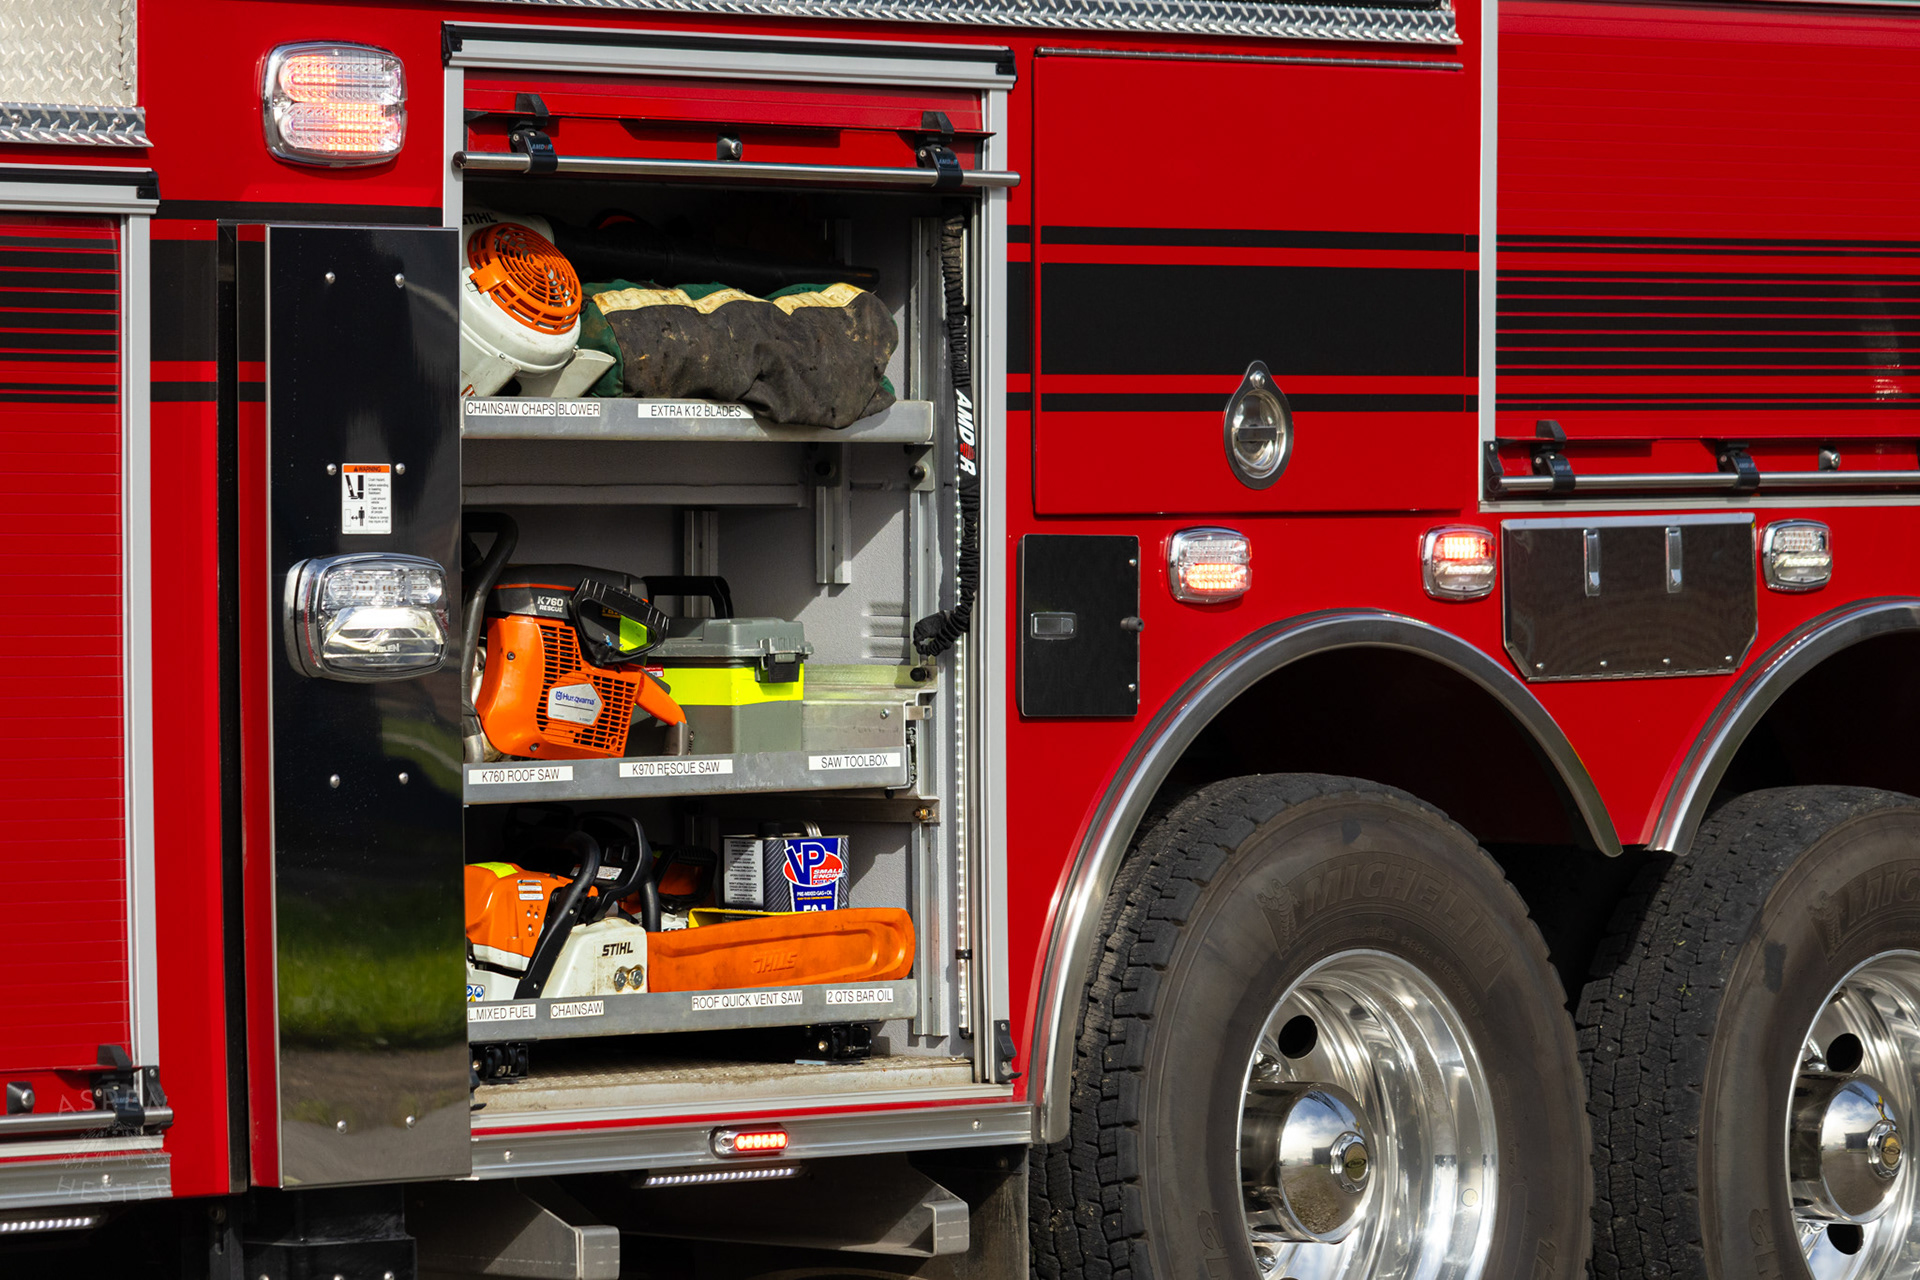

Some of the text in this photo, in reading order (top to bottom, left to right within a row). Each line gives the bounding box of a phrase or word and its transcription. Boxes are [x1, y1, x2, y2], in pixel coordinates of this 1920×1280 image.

[467, 402, 555, 416] CHAINSAW CHAPS
[558, 404, 600, 416] BLOWER
[651, 405, 742, 418] EXTRA K12 BLADES
[537, 595, 564, 607] K760
[539, 604, 563, 613] RESCUE
[632, 761, 720, 776] K970 RESCUE SAW
[821, 754, 888, 769] SAW TOOLBOX
[482, 768, 560, 783] K760 ROOF SAW
[784, 842, 827, 887] VP
[1303, 861, 1507, 968] MICHELIN
[602, 942, 633, 956] STIHL
[692, 991, 802, 1009] ROOF QUICK VENT SAW
[827, 989, 892, 1003] 2 QTS BAR OIL
[509, 1005, 534, 1018] FUEL
[551, 1002, 603, 1017] CHAINSAW
